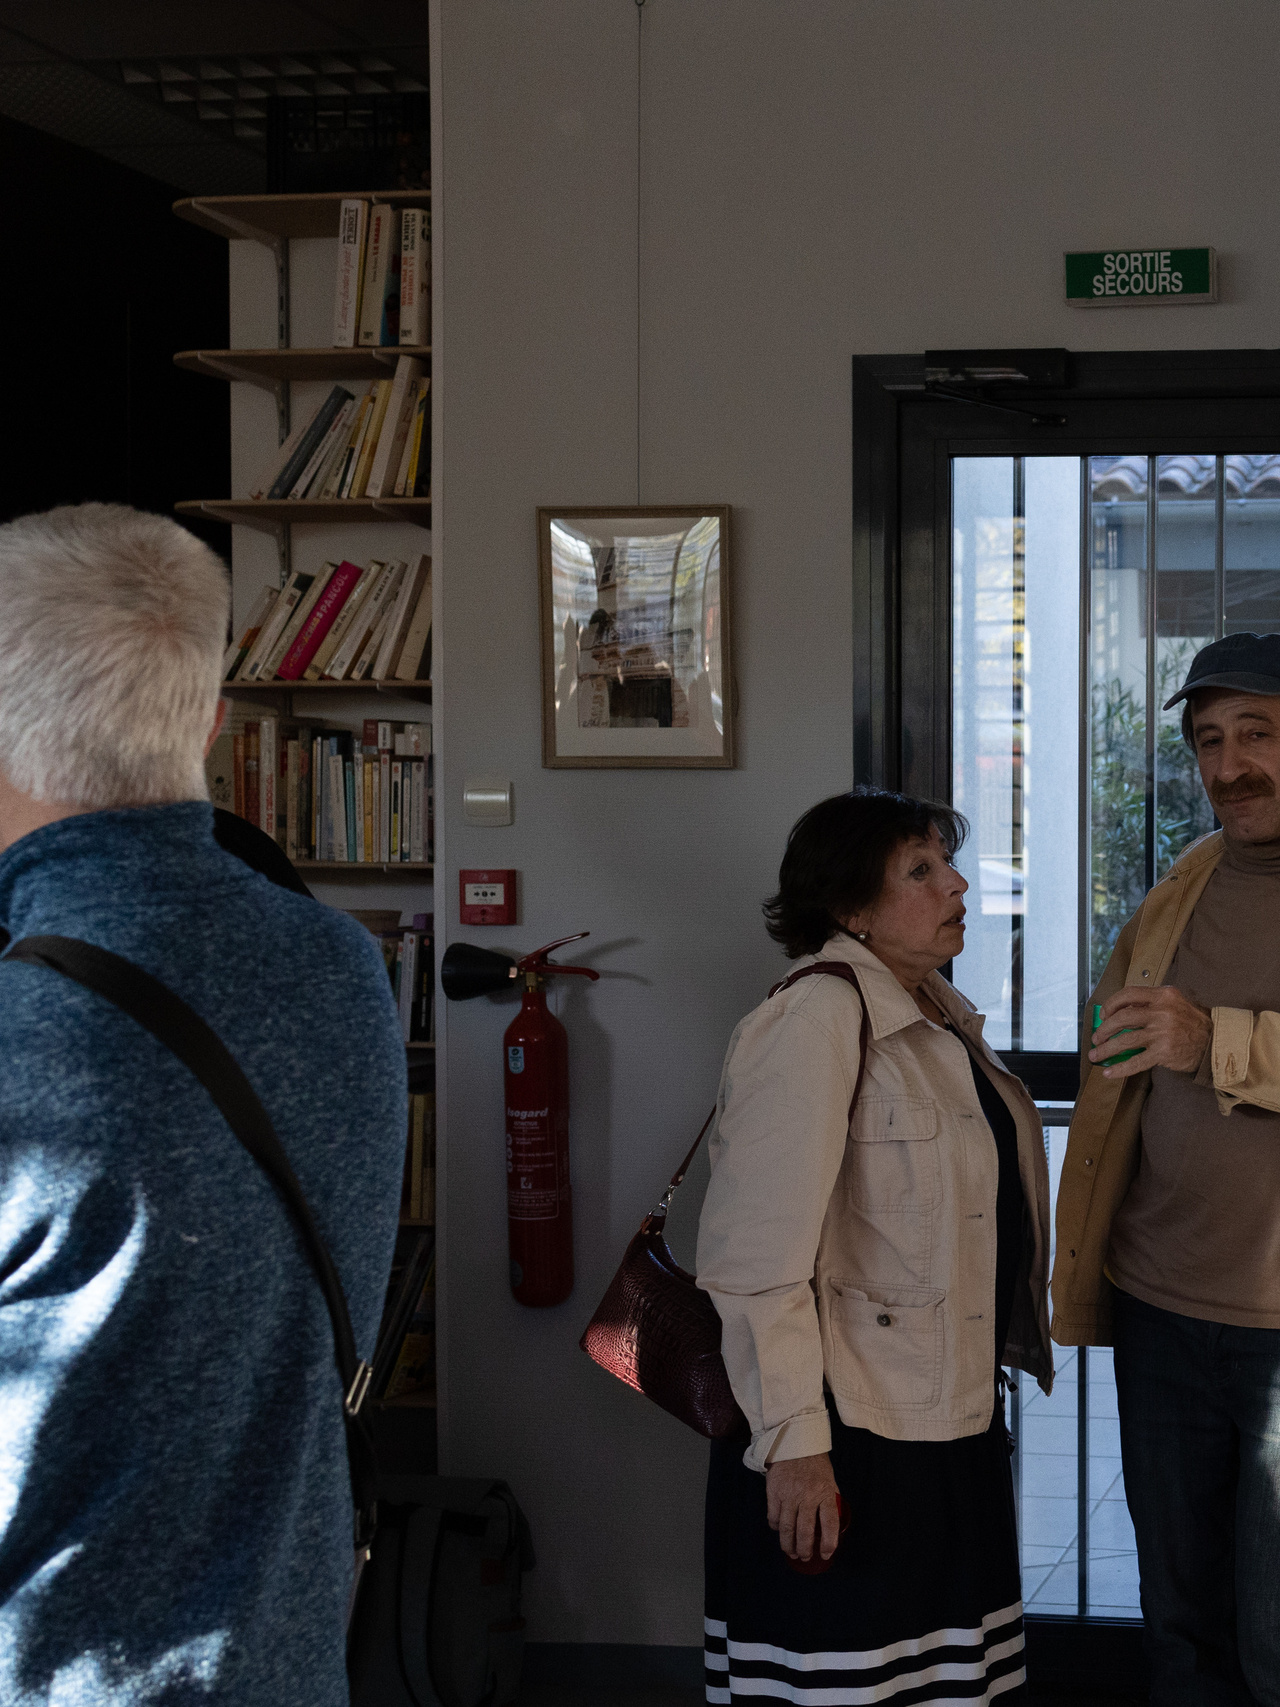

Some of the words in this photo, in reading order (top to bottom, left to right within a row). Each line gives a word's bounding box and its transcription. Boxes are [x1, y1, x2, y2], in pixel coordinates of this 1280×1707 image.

[1103, 251, 1171, 274] SORTIE
[1092, 271, 1183, 295] SECOURS
[320, 573, 349, 614] PANCOL
